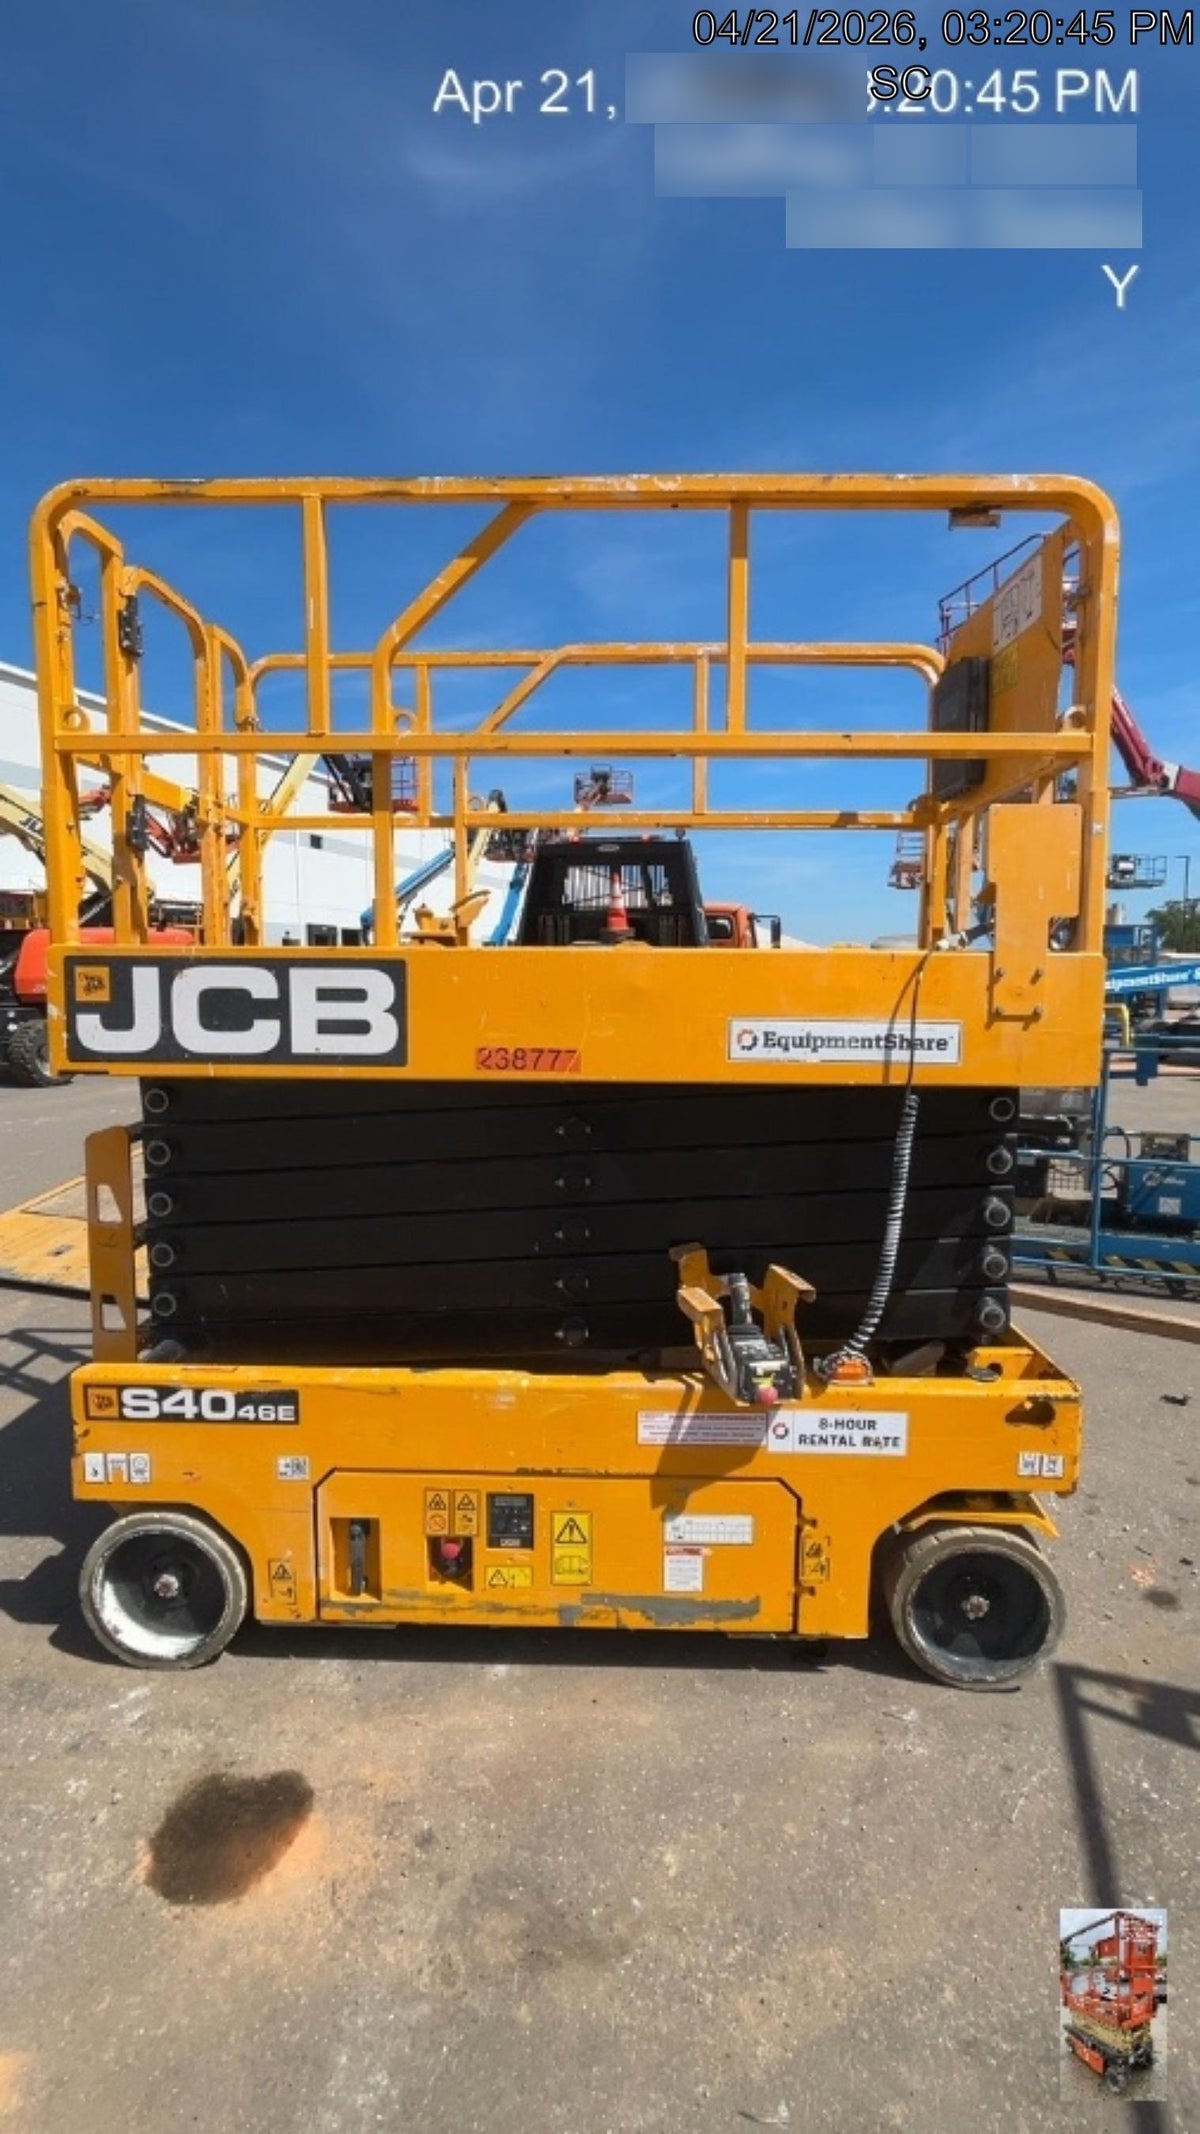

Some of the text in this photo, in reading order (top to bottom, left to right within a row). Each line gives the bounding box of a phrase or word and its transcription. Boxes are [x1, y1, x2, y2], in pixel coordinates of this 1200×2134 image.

[75, 966, 400, 1055] JCB
[762, 1030, 949, 1053] EquipmentShare
[476, 1047, 579, 1072] 238777
[819, 1417, 877, 1431] 8-HOUR
[798, 1433, 901, 1448] RENTAL RATE
